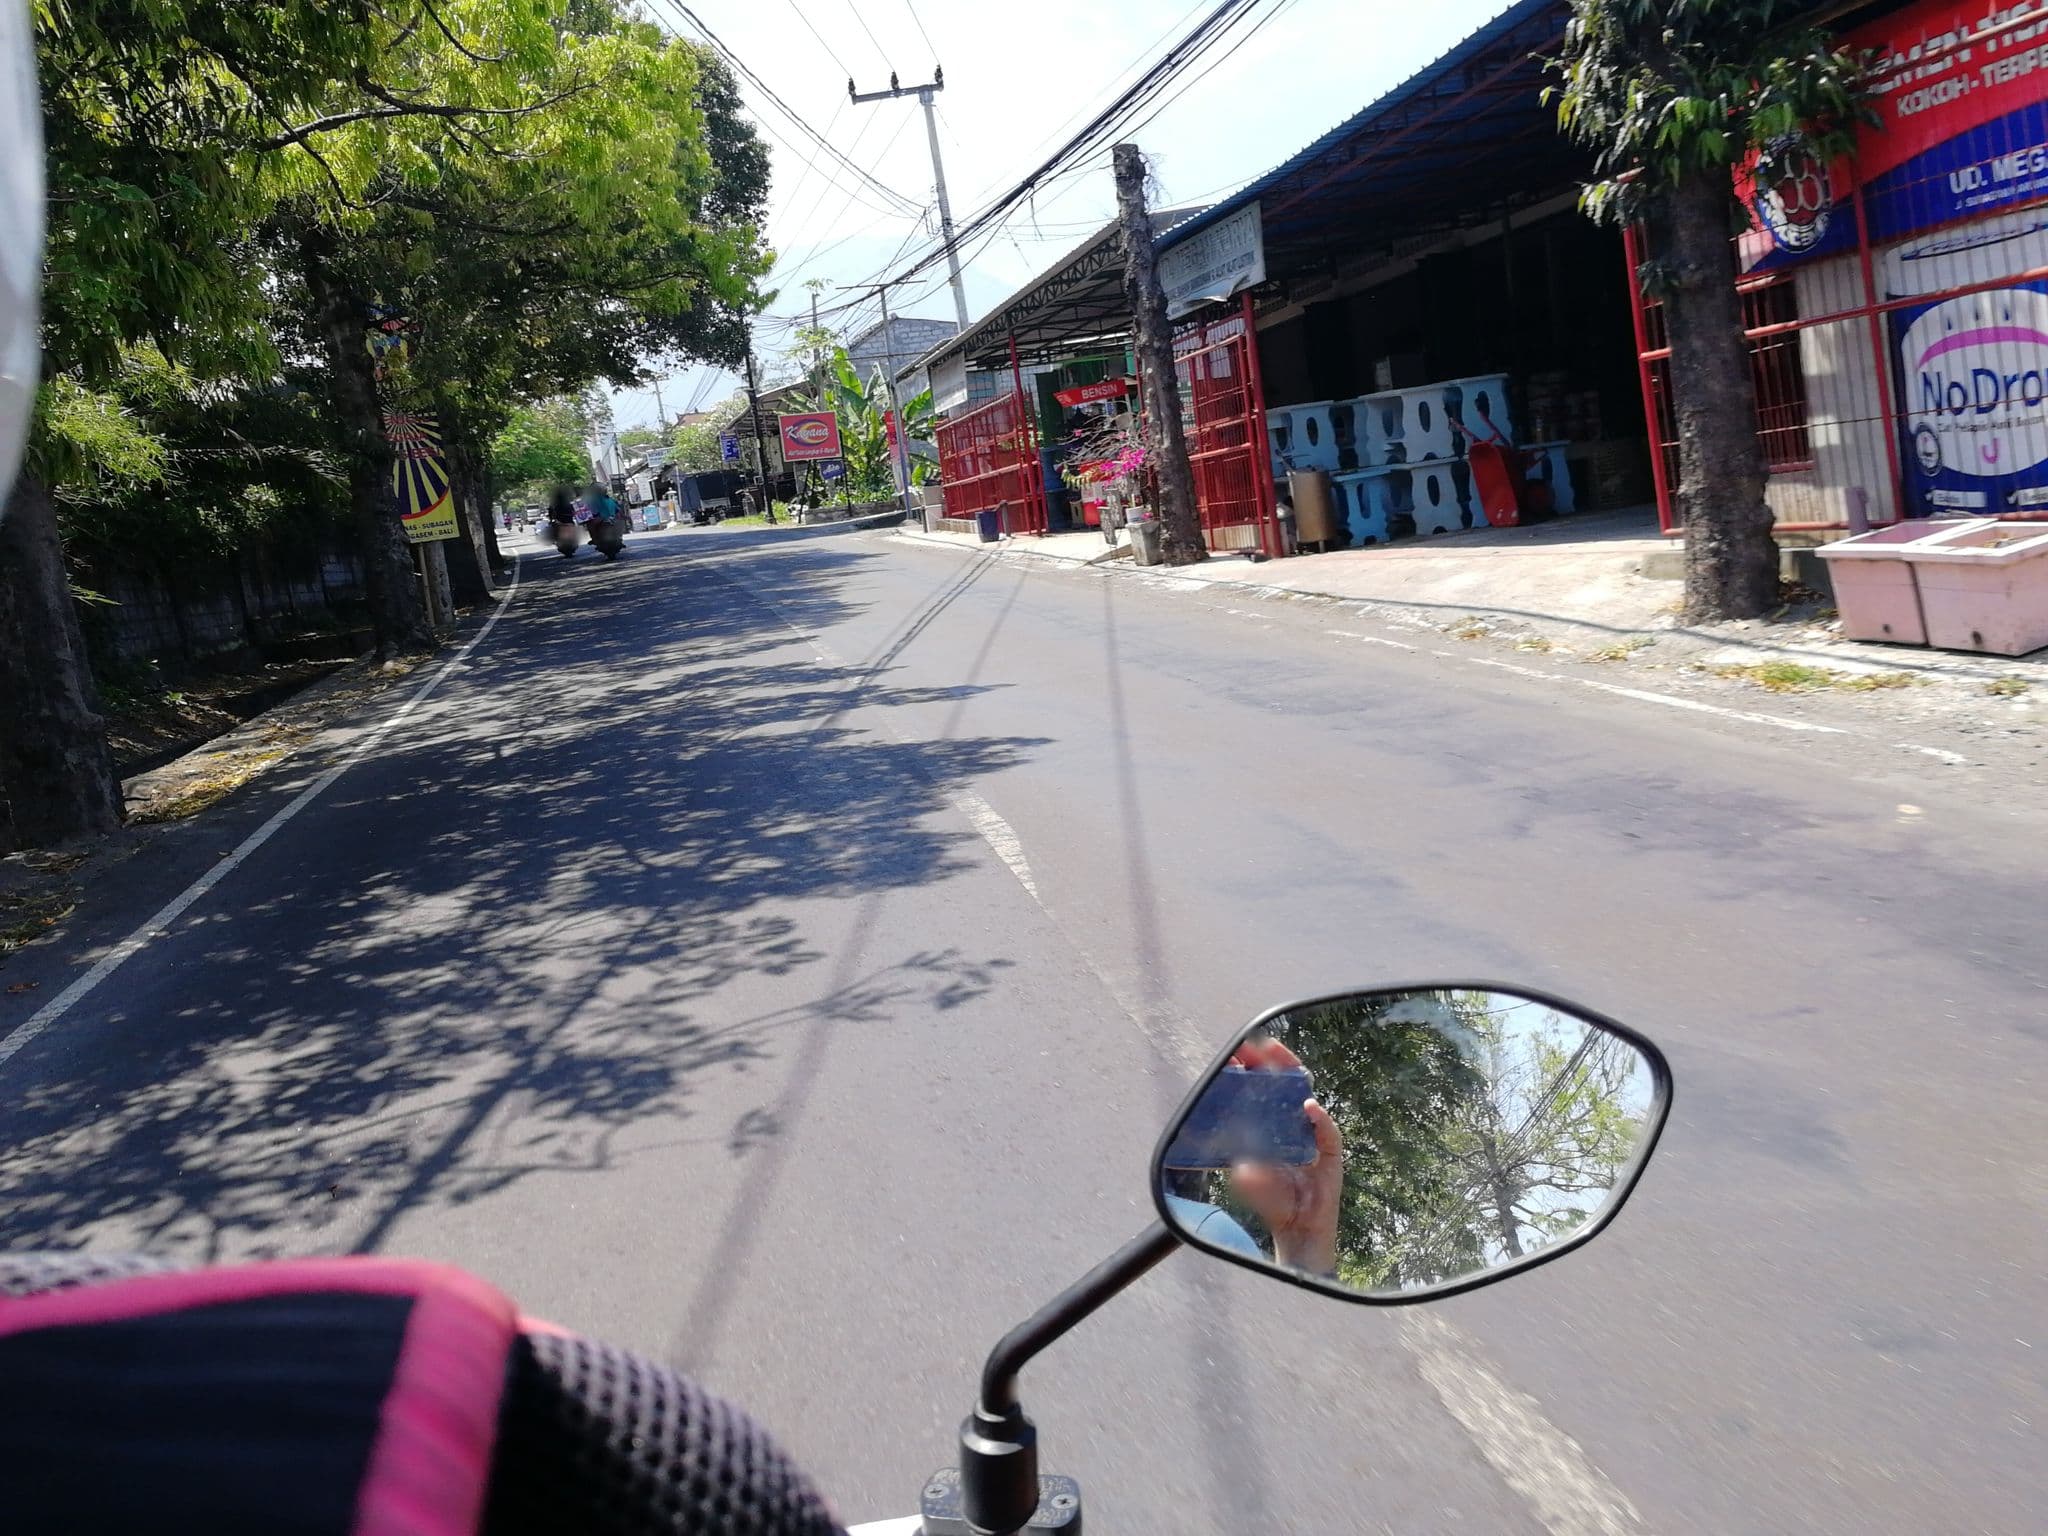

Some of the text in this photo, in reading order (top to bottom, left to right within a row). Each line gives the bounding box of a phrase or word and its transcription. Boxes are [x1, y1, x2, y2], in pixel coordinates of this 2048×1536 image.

[1896, 73, 1970, 117] KOKOH
[1949, 166, 1988, 194] UD.
[1991, 147, 2048, 183] MEG
[1081, 384, 1117, 399] BENSIN
[1922, 367, 2048, 416] NoDro
